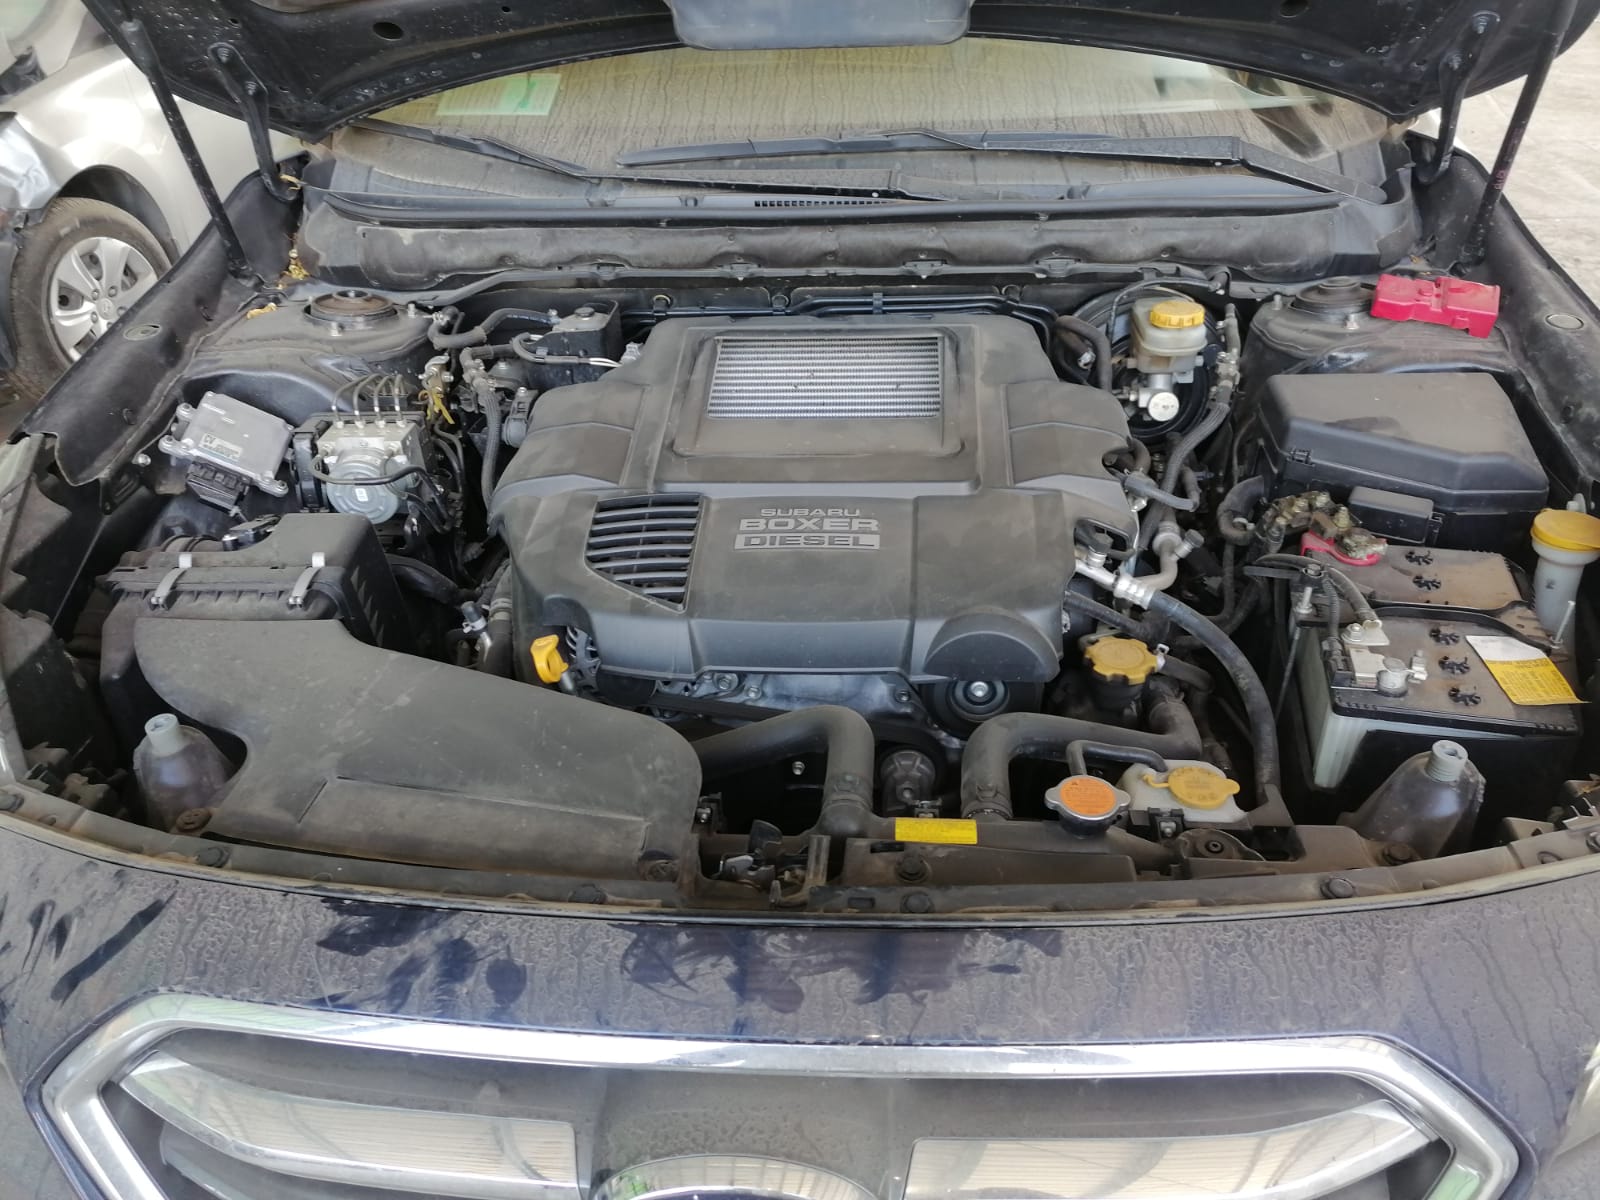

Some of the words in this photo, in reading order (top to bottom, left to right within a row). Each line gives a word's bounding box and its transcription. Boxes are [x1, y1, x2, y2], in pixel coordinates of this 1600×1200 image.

[761, 508, 861, 517] SUBARU
[739, 518, 880, 532] BOXER
[742, 535, 876, 548] DIESEL
